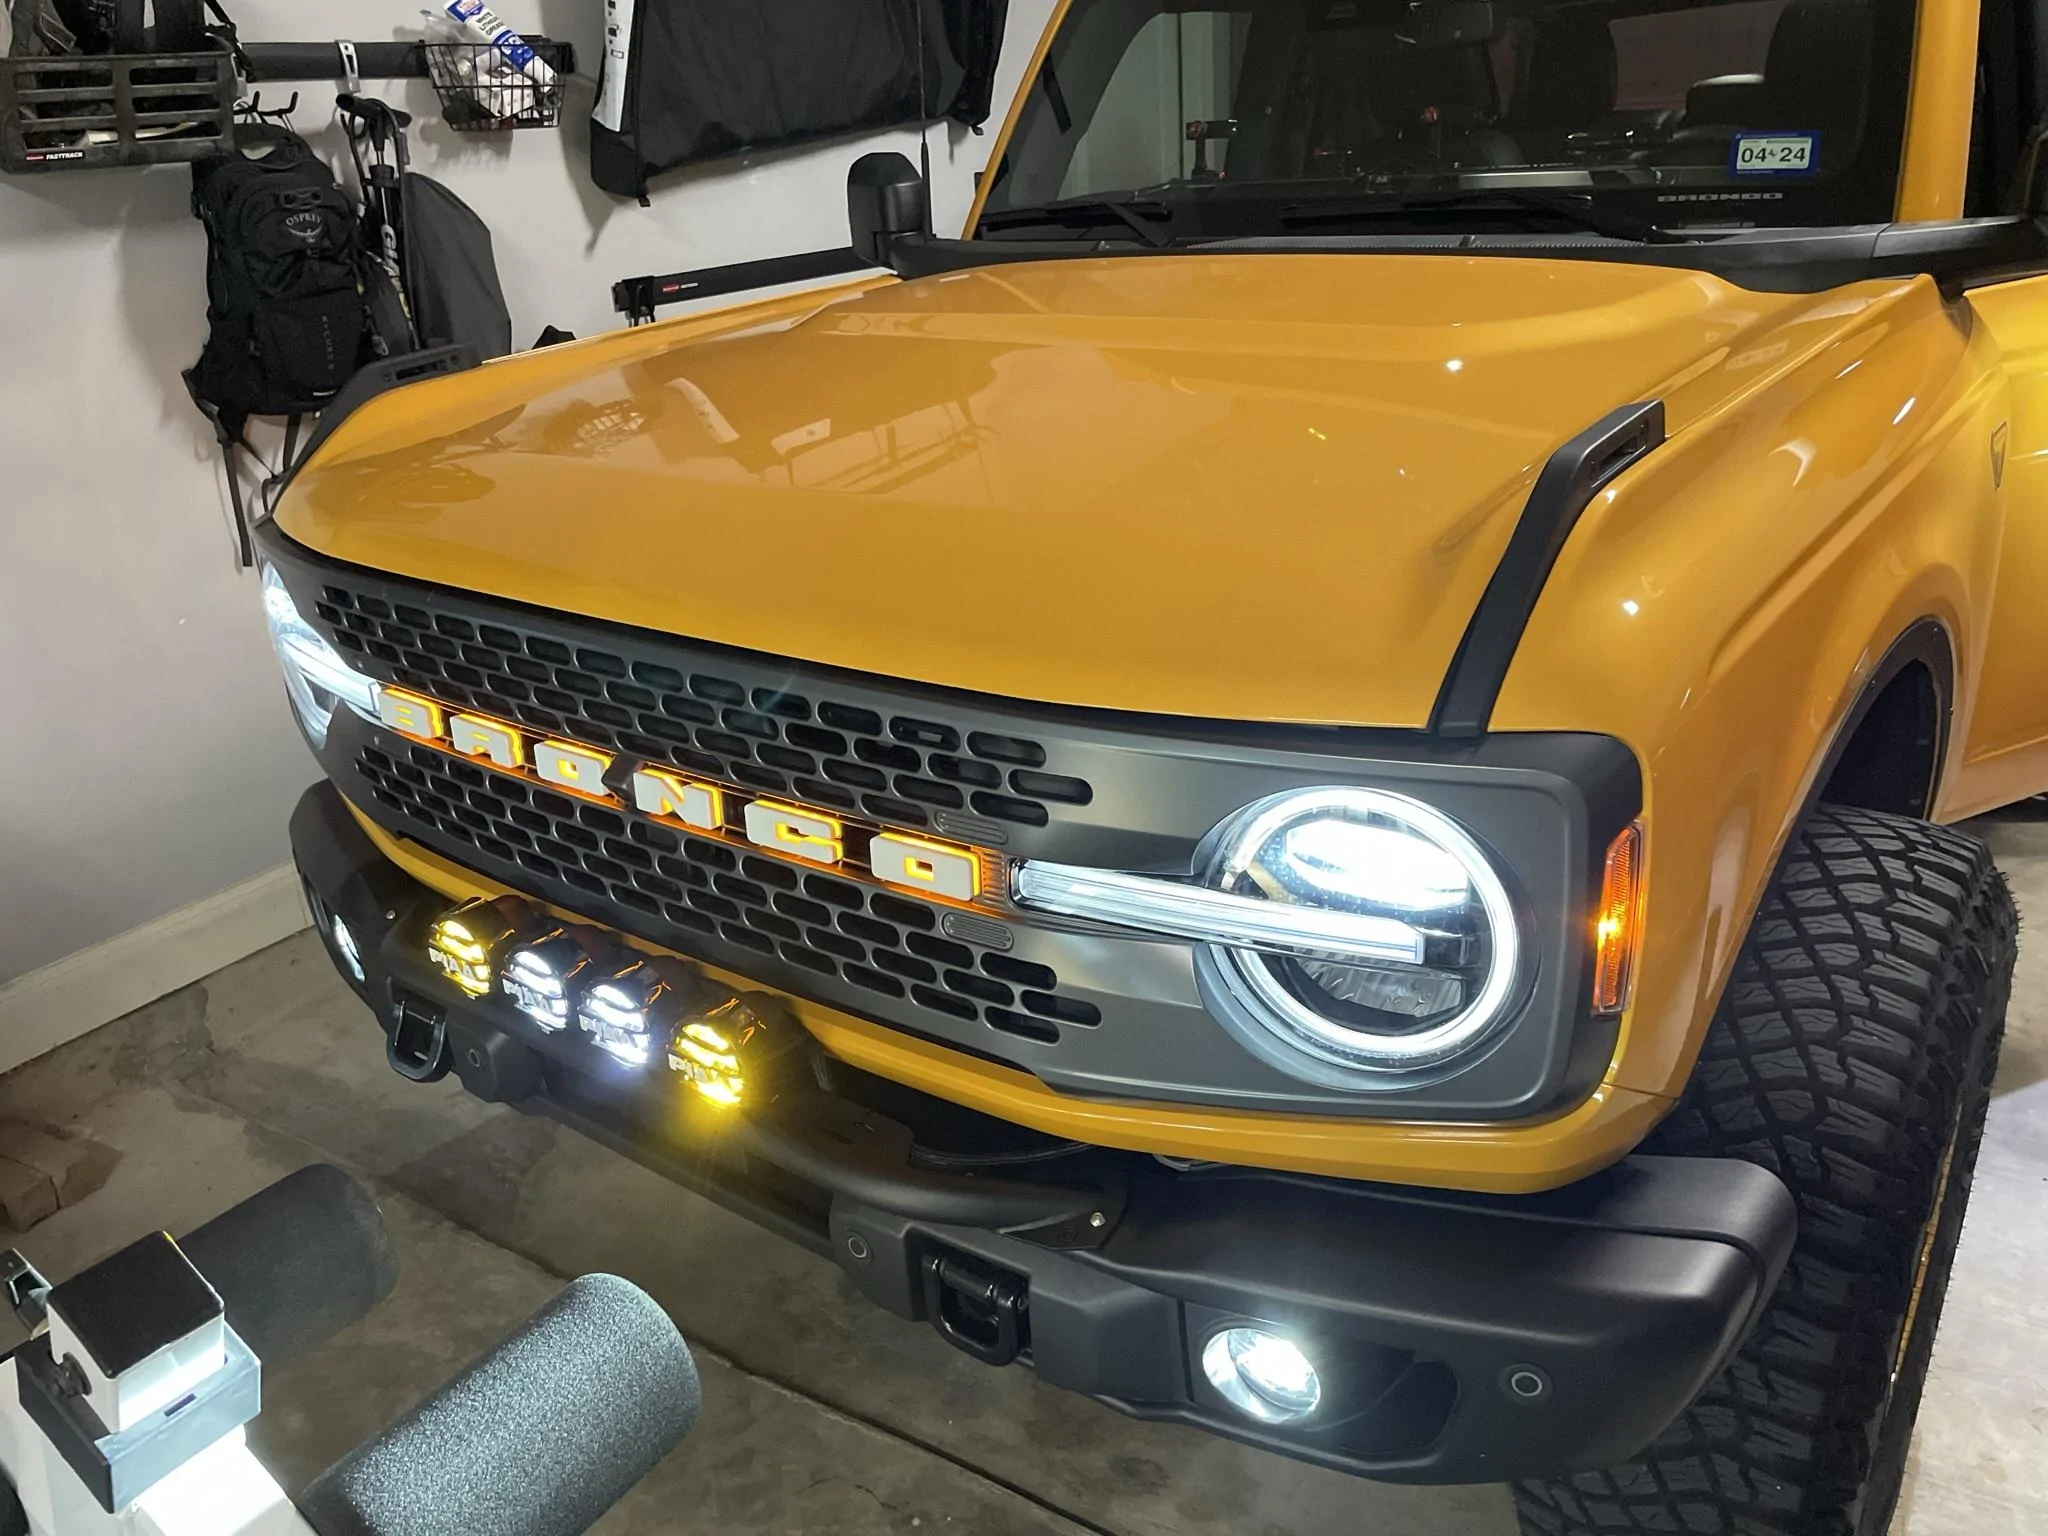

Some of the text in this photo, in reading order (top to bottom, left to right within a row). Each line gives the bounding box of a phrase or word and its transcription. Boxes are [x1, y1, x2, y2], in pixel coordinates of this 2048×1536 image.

[46, 151, 83, 160] FASTTRACK
[1741, 147, 1806, 163] 04 24
[1657, 192, 1783, 202] BRONCO
[286, 213, 322, 226] OSPREY
[378, 689, 981, 902] BRONCO
